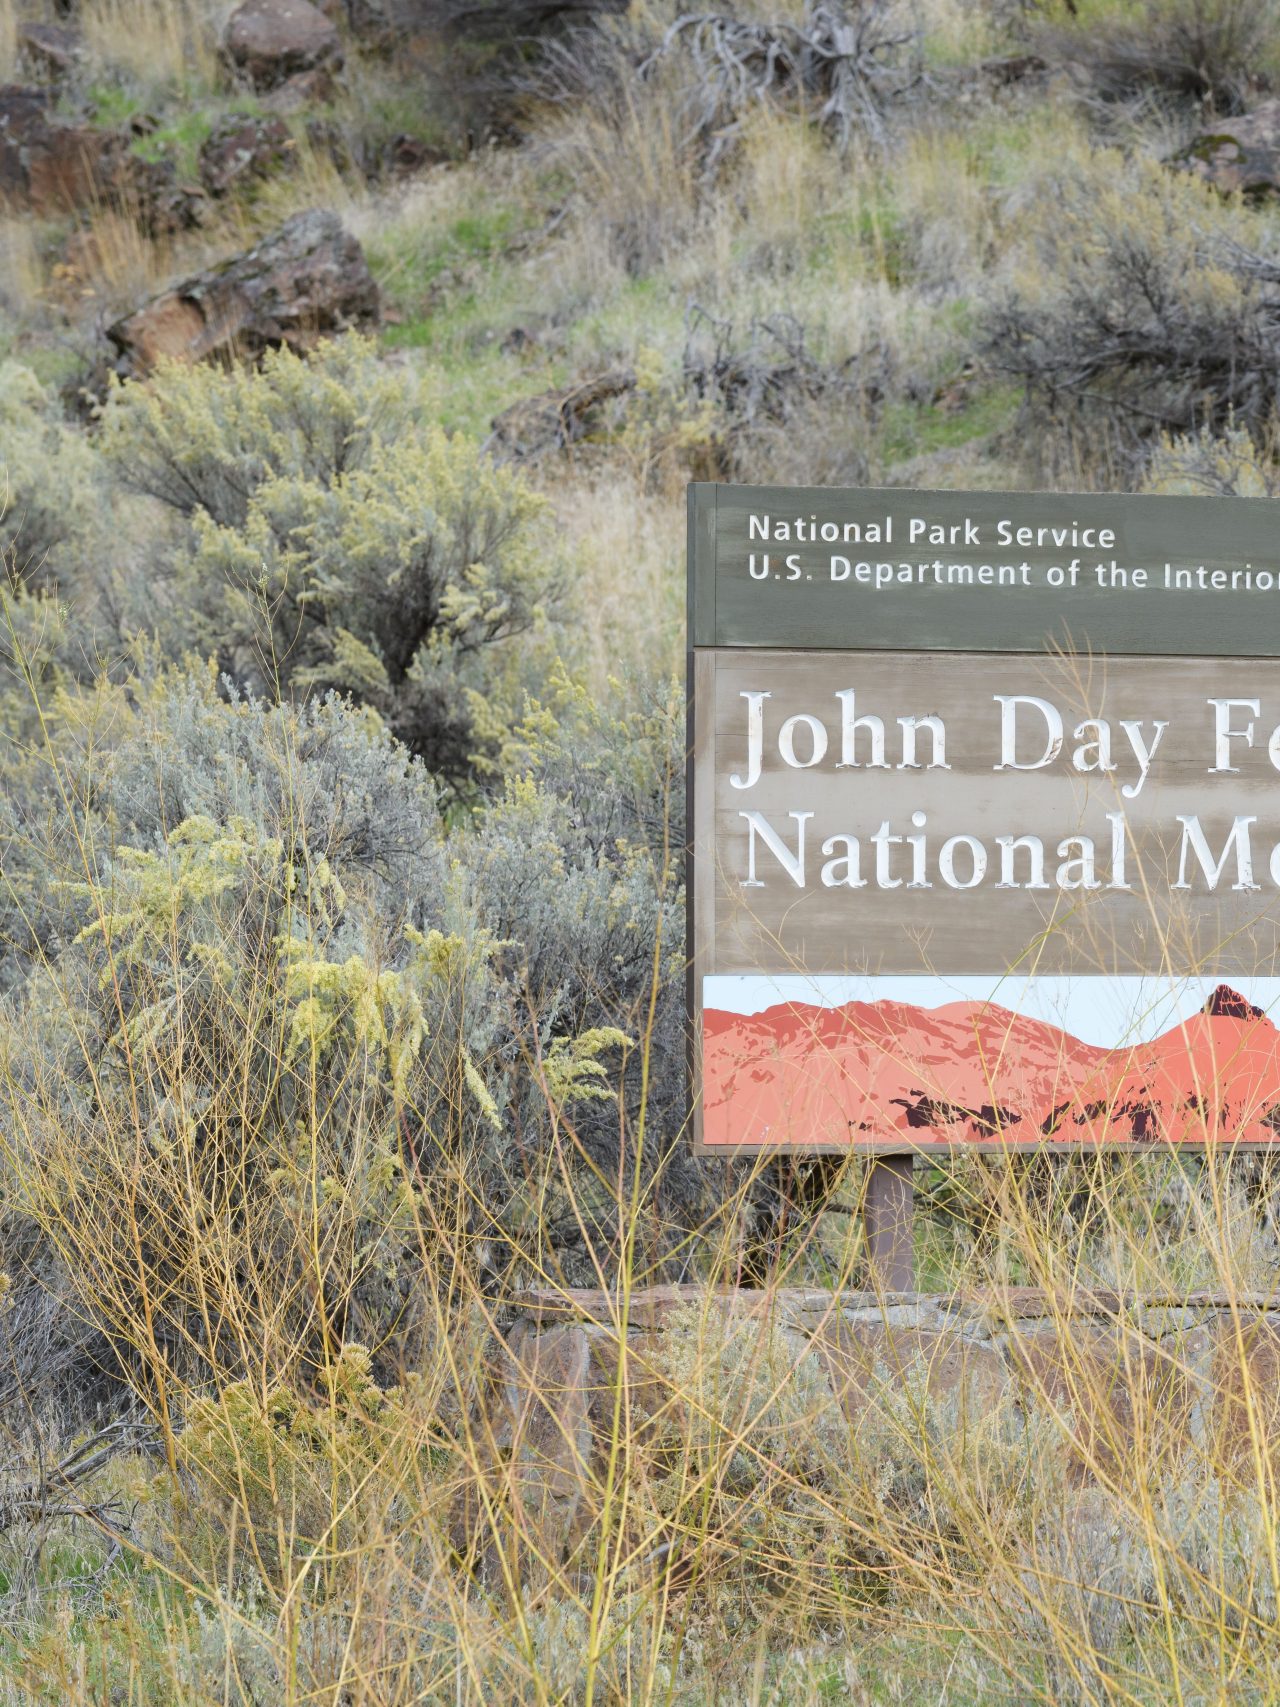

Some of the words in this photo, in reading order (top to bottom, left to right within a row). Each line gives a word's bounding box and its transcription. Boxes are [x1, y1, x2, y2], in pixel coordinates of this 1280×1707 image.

[748, 513, 893, 543] National
[908, 517, 981, 546] Park
[996, 519, 1117, 549] Service
[748, 554, 814, 582] U.S.
[829, 555, 1033, 589] Department
[1046, 558, 1081, 587] of
[1095, 560, 1149, 588] the
[729, 688, 952, 790] John
[992, 694, 1170, 799] Day
[738, 810, 1132, 890] National
